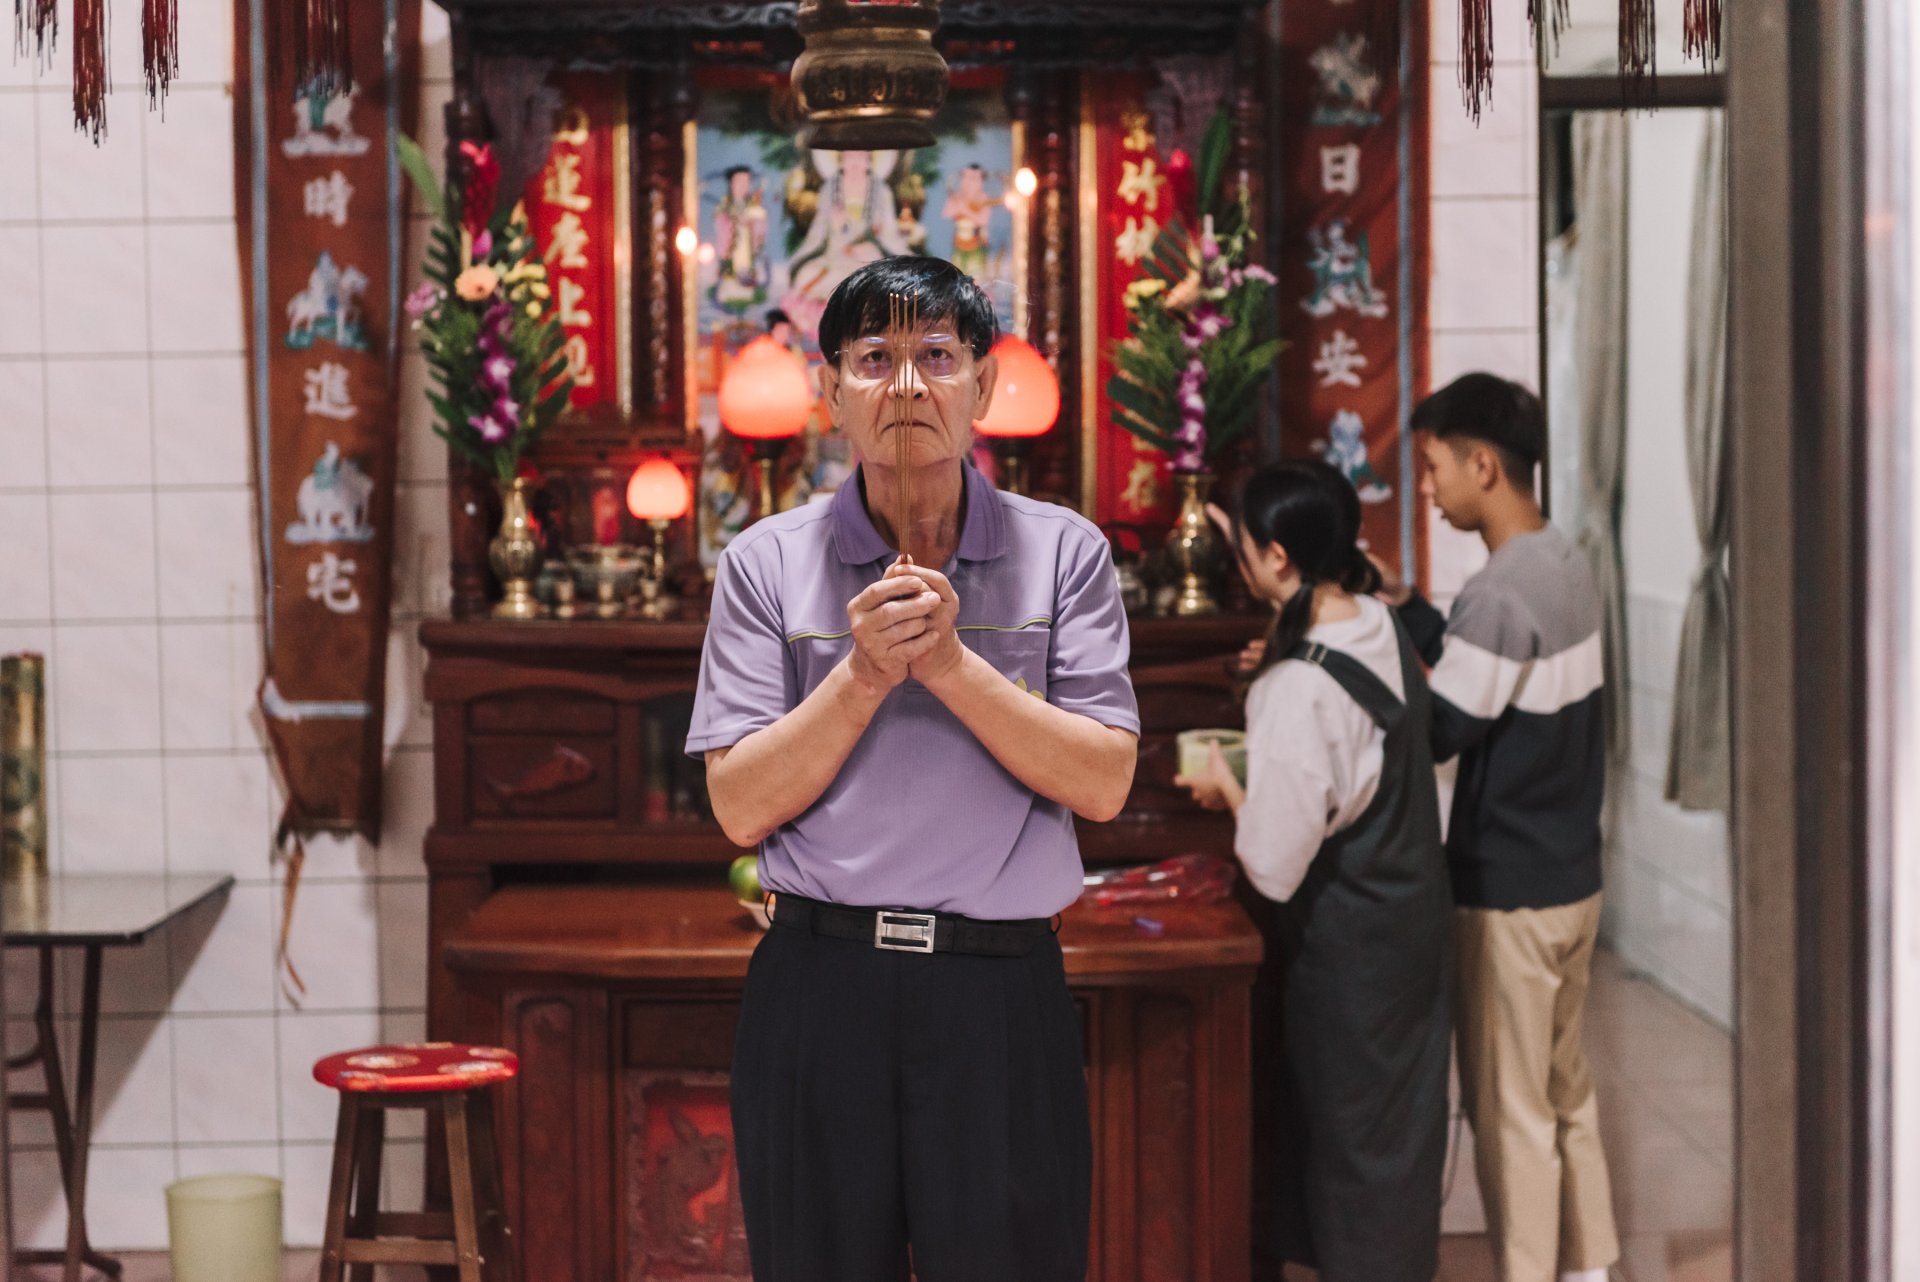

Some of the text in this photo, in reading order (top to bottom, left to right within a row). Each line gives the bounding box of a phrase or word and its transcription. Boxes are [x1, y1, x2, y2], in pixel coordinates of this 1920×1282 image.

[303, 170, 355, 227] 時
[1312, 143, 1368, 388] 日 安
[306, 552, 361, 614] 宅
